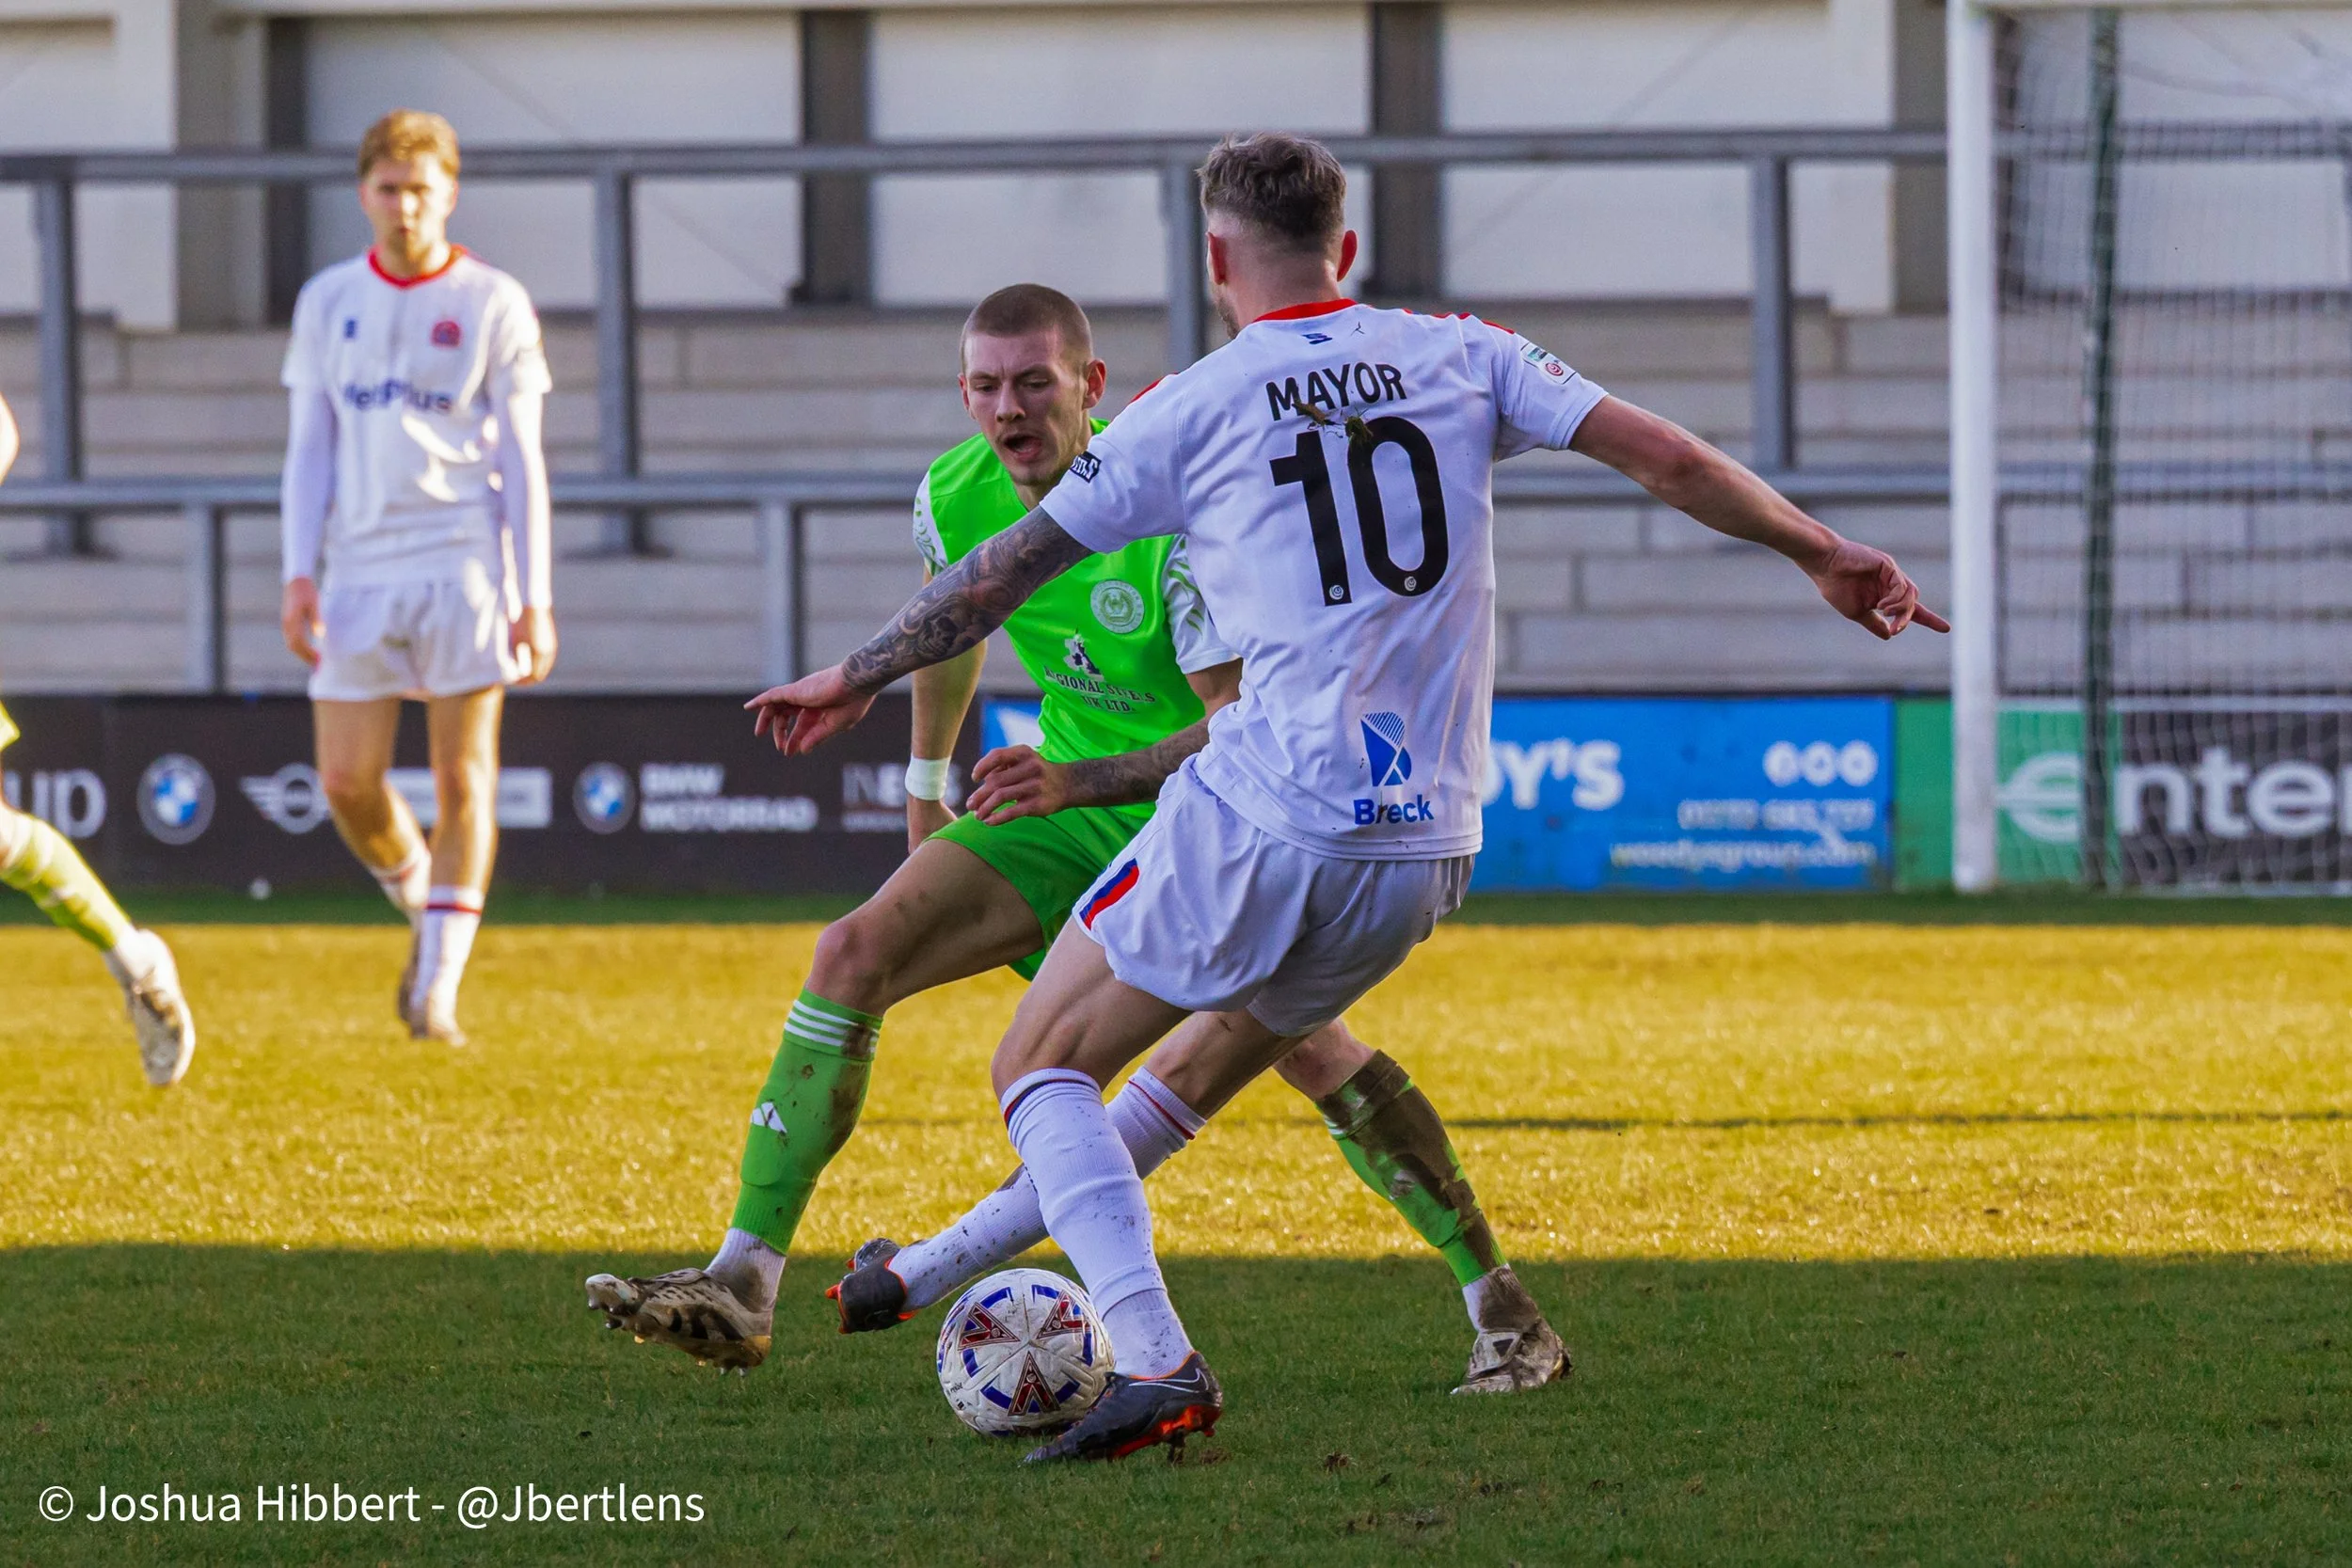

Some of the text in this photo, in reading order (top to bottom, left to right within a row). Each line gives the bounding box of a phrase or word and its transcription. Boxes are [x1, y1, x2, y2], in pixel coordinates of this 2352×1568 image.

[1265, 361, 1407, 421] MAYOR
[1269, 415, 1449, 607] 10
[1044, 667, 1104, 693] RGIONAL
[1482, 738, 1626, 810] Y'S
[1353, 794, 1435, 825] Breck
